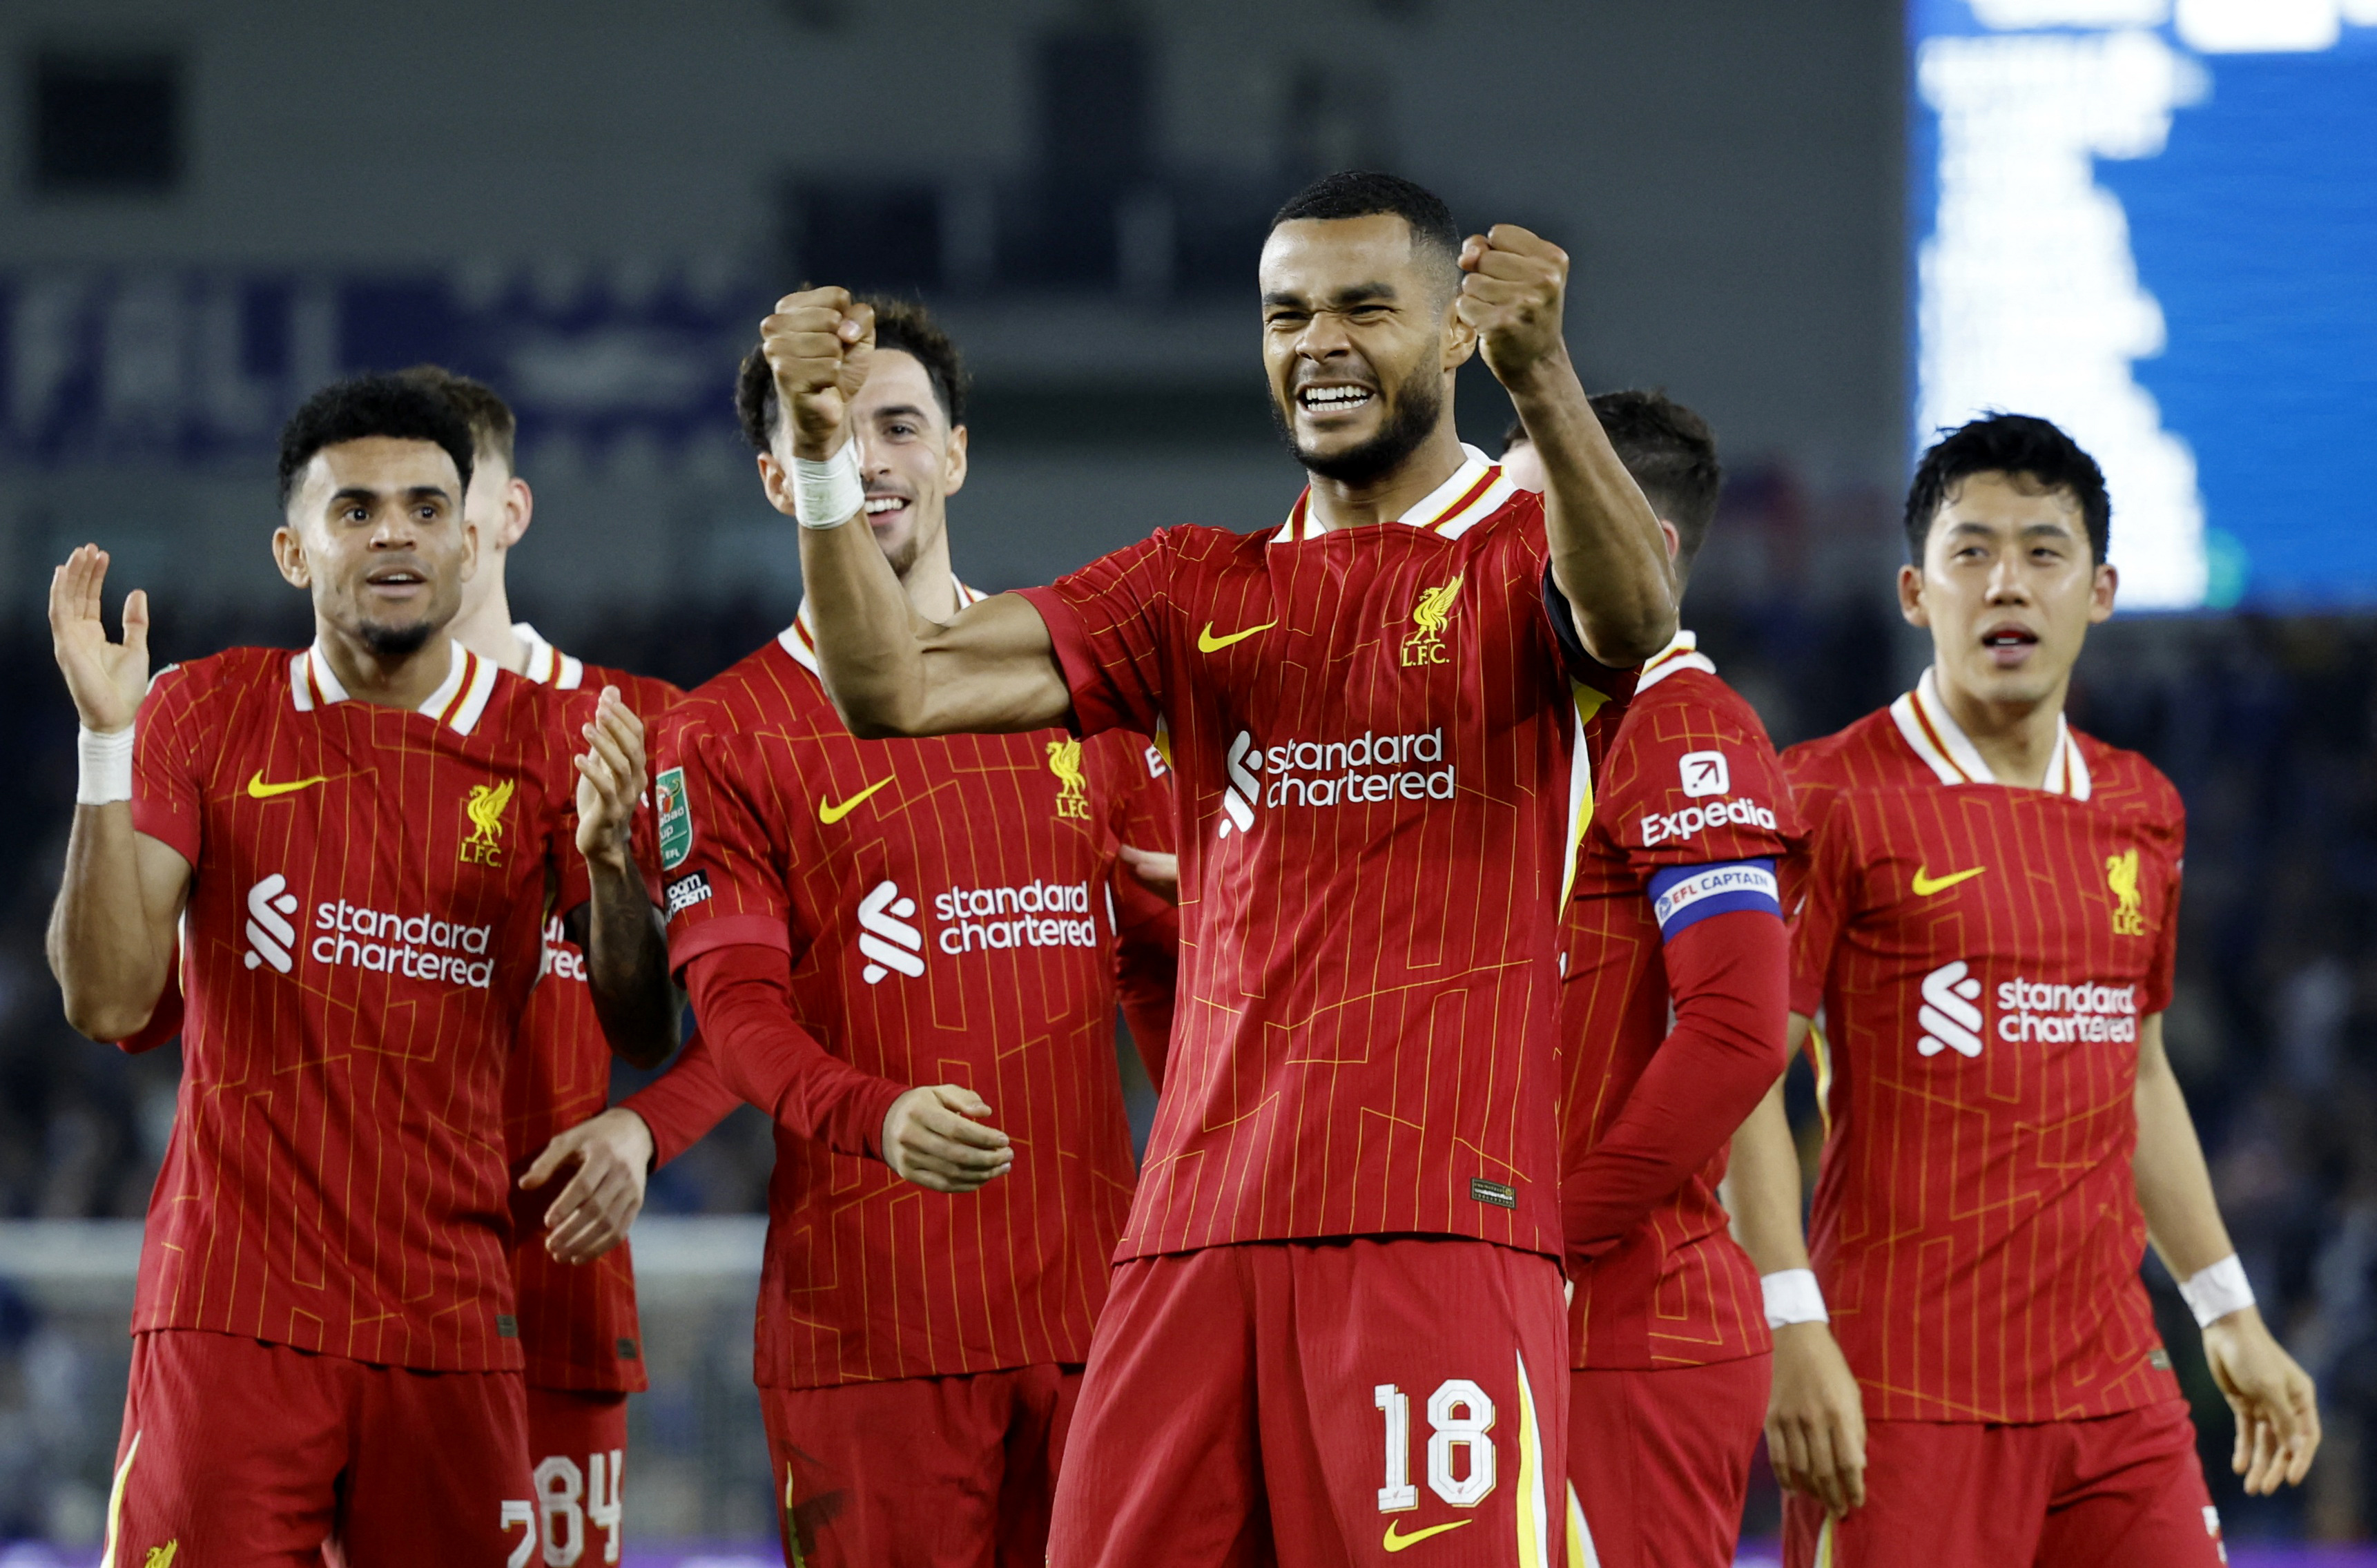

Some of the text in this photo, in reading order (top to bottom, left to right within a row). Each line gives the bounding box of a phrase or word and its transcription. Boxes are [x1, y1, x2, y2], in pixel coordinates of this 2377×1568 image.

[1401, 643, 1450, 667] L.F.C.
[1268, 727, 1442, 774] standard
[1267, 764, 1455, 809] chartered
[660, 825, 674, 840] up
[1640, 797, 1778, 847] Expedia
[668, 873, 701, 899] oom
[935, 878, 1089, 921] standard
[1671, 872, 1769, 904] EFL CAPTAIN
[316, 898, 492, 956] standard
[939, 913, 1097, 955] chartered
[311, 933, 495, 989] chartered
[1997, 976, 2137, 1014] standard
[1998, 1010, 2135, 1043] chartered
[1375, 1379, 1496, 1514] 18
[534, 1448, 622, 1568] 84
[501, 1500, 537, 1568] 7
